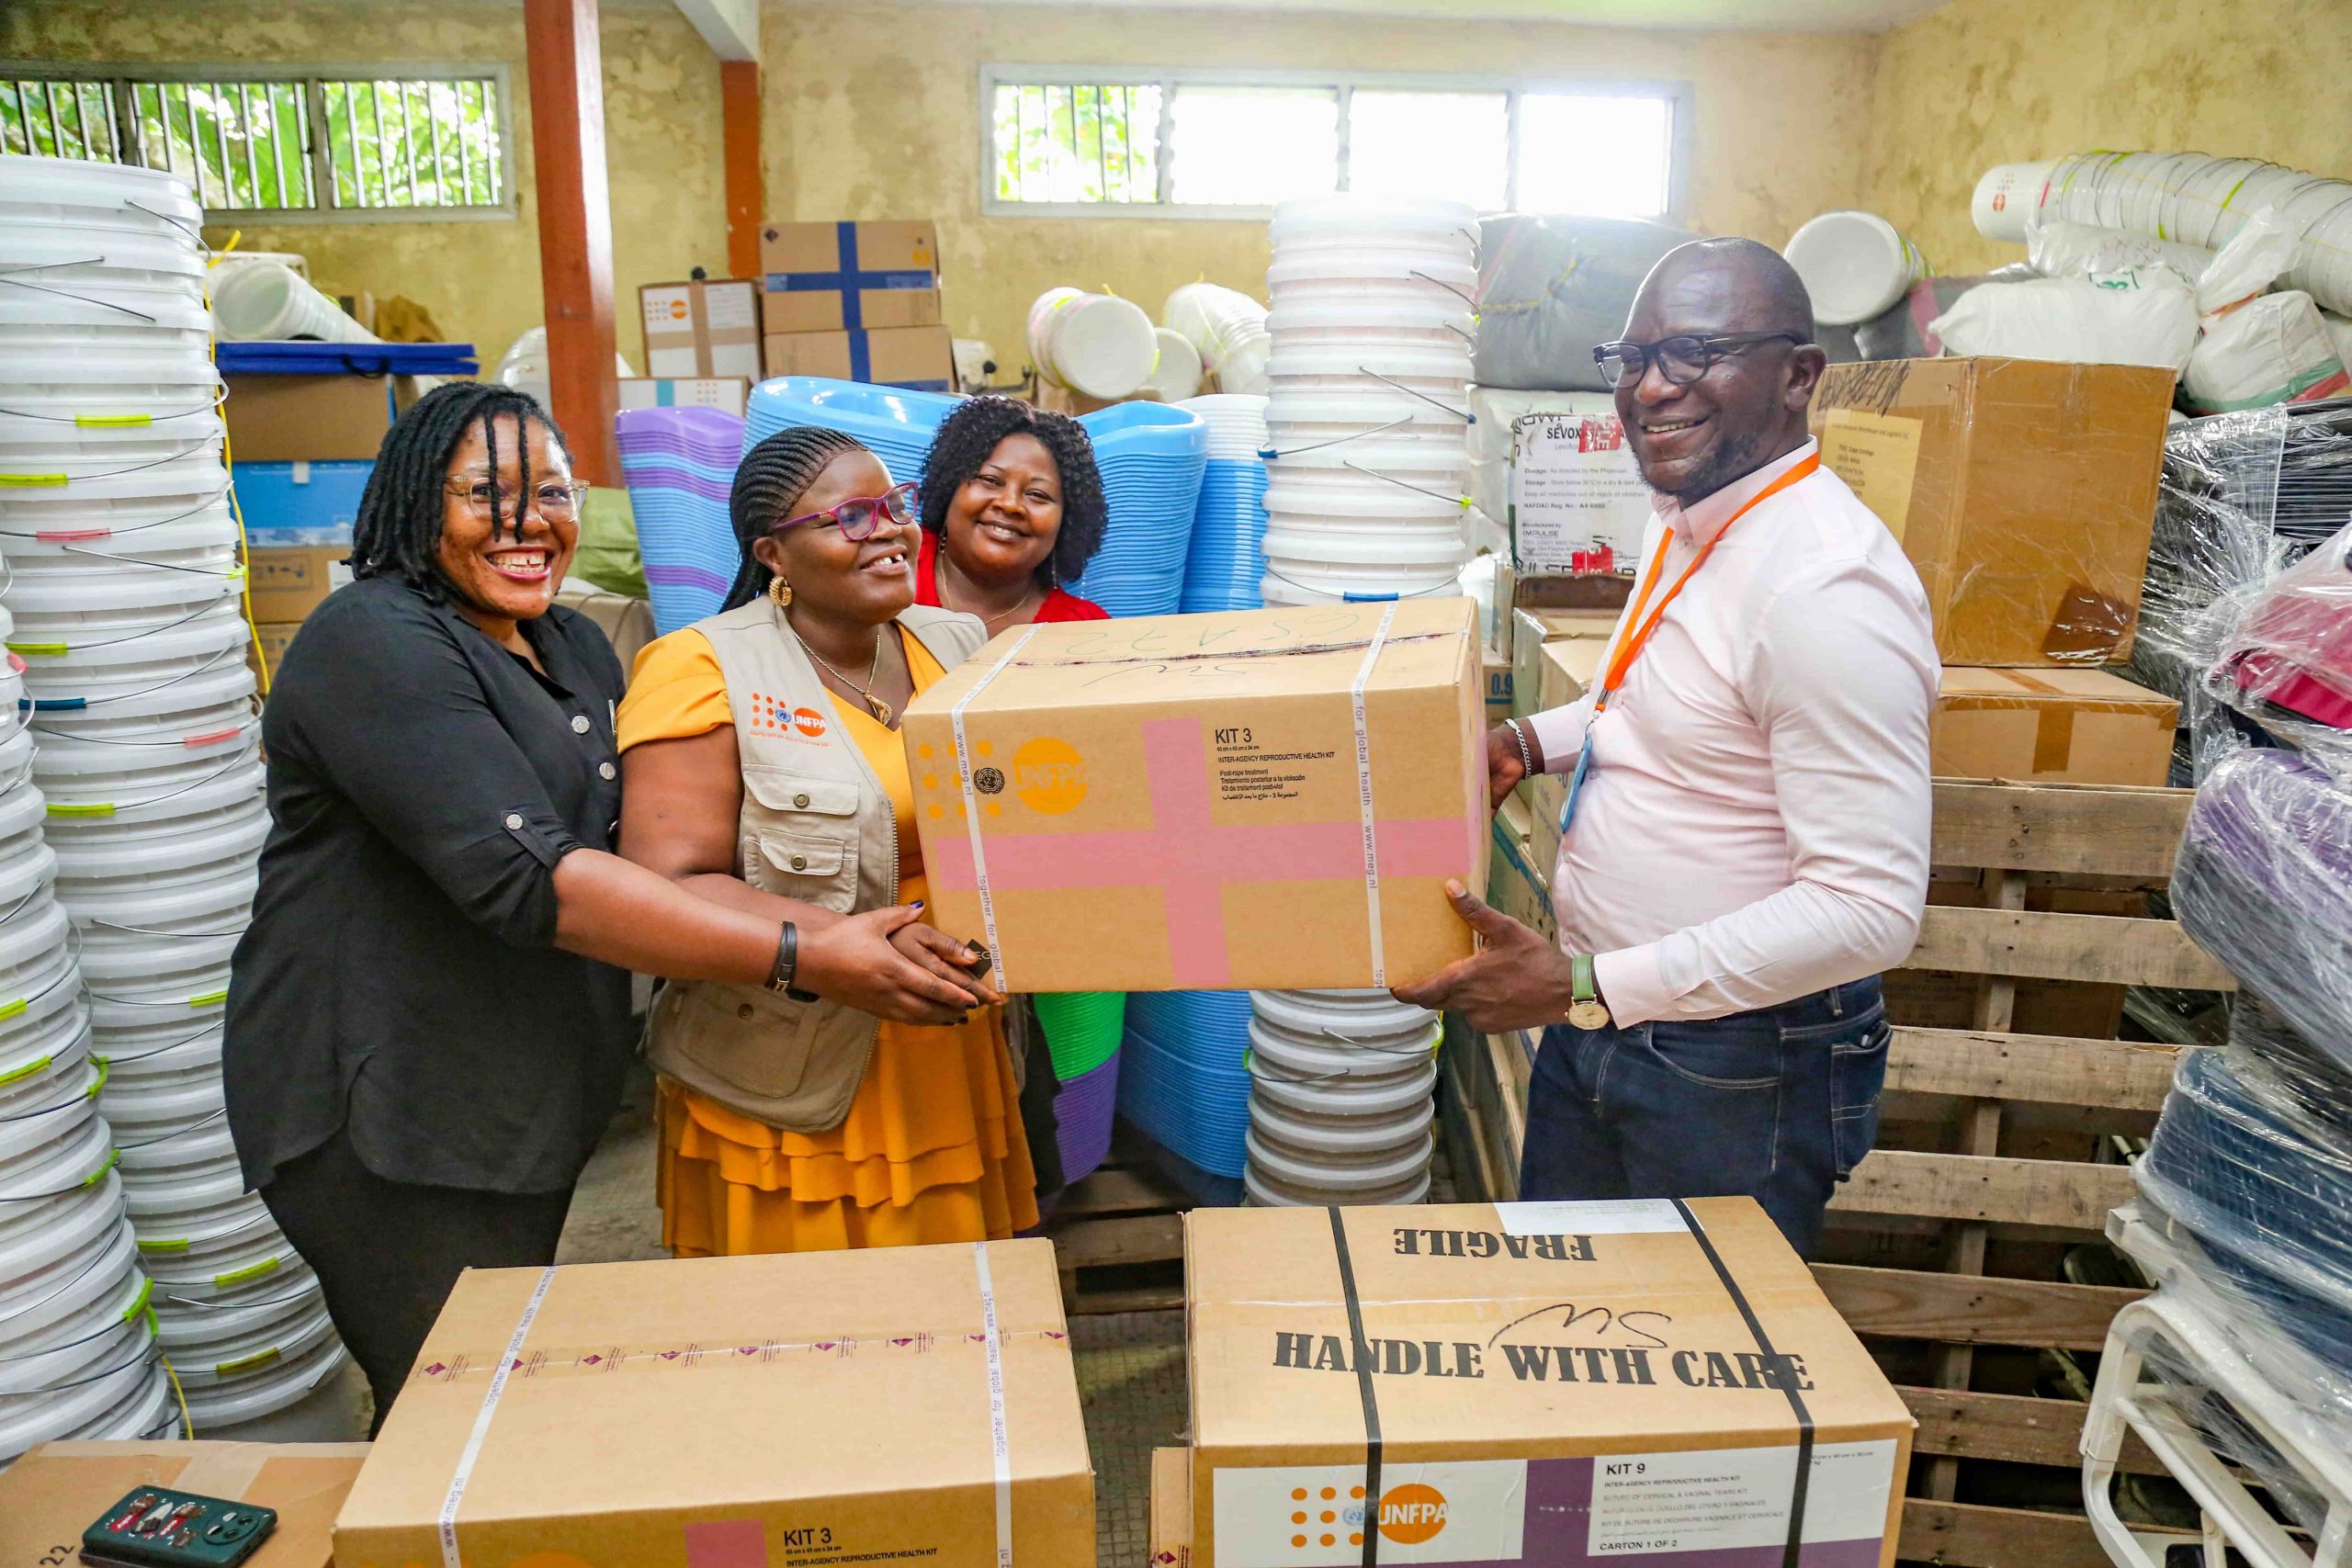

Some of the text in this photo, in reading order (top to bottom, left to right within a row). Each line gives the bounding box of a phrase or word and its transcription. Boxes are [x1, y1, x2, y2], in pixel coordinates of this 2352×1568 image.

[792, 714, 827, 729] UNFPA
[1355, 705, 1364, 722] for
[1215, 728, 1252, 744] KIT 3
[1354, 729, 1368, 763] global
[956, 733, 974, 795] www.meg.nl
[1218, 755, 1259, 763] INTER-AGENCY
[1260, 753, 1303, 761] REPRODUCTIVE
[1304, 751, 1325, 760] HEALTH
[1250, 776, 1272, 784] posterior
[1360, 772, 1372, 806] health
[1364, 825, 1377, 889] www.meg.nl
[988, 924, 996, 936] for
[989, 943, 1003, 973] global
[1394, 1229, 1599, 1262] FRAGILE
[501, 1355, 513, 1371] for
[509, 1331, 525, 1354] global
[520, 1307, 535, 1329] health
[989, 1340, 1000, 1363] health
[1273, 1332, 1815, 1391] HANDLE WITH CARE
[989, 1370, 1002, 1393] global
[992, 1400, 1002, 1412] for
[1606, 1462, 1645, 1475] KIT 9
[1653, 1477, 1702, 1485] REPRODUCTIVE
[1377, 1502, 1449, 1526] UNFPA
[784, 1527, 831, 1547] KIT 3
[1600, 1541, 1643, 1551] CARTON
[1655, 1540, 1668, 1548] OF
[786, 1548, 938, 1568] INTER-AGENCY REPRODUCTIVE HEALTH KIT
